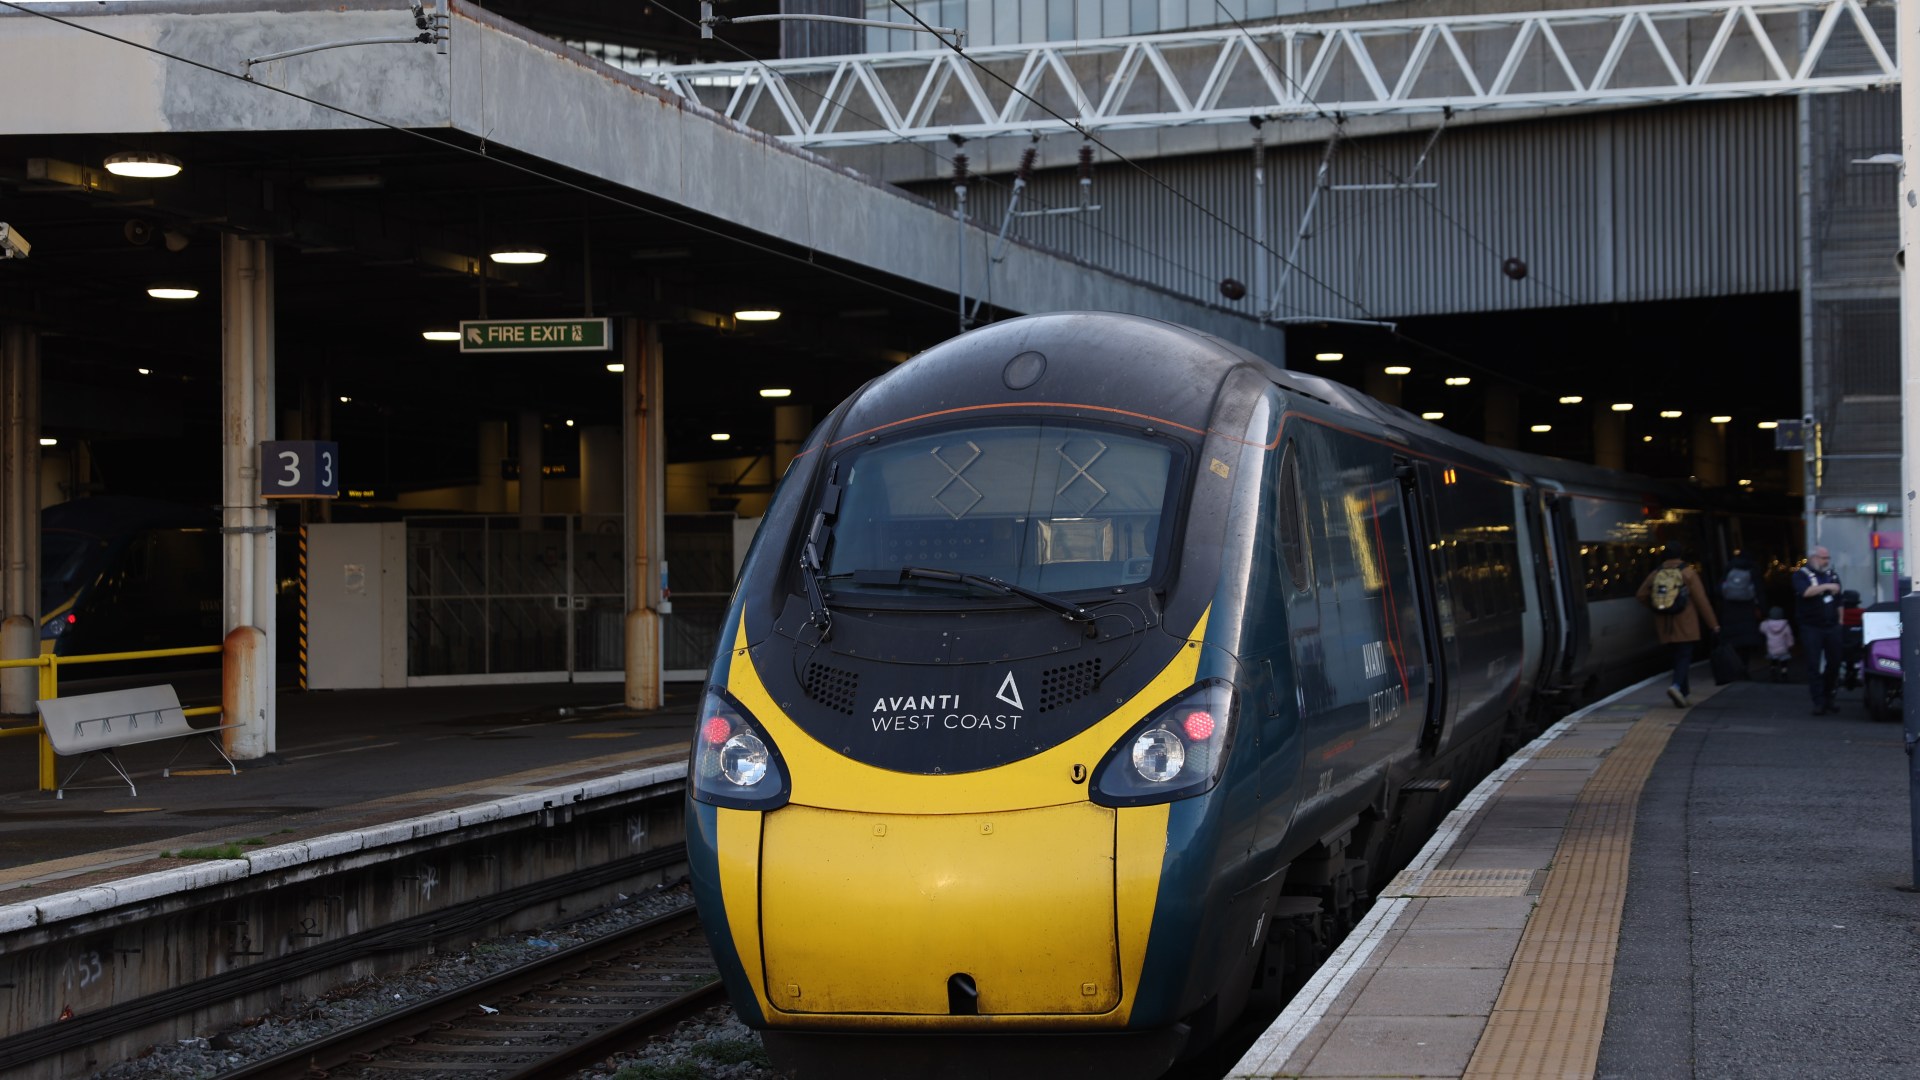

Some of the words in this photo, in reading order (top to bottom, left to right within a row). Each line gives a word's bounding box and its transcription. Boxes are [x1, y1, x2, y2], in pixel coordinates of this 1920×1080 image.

[488, 326, 525, 342] FIRE
[531, 325, 567, 341] EXIT
[277, 450, 301, 488] 3
[321, 451, 333, 488] 3
[363, 489, 375, 498] out
[872, 694, 960, 713] AVANTI
[871, 714, 935, 732] WEST
[943, 713, 1022, 730] COAST
[79, 950, 102, 988] 53
